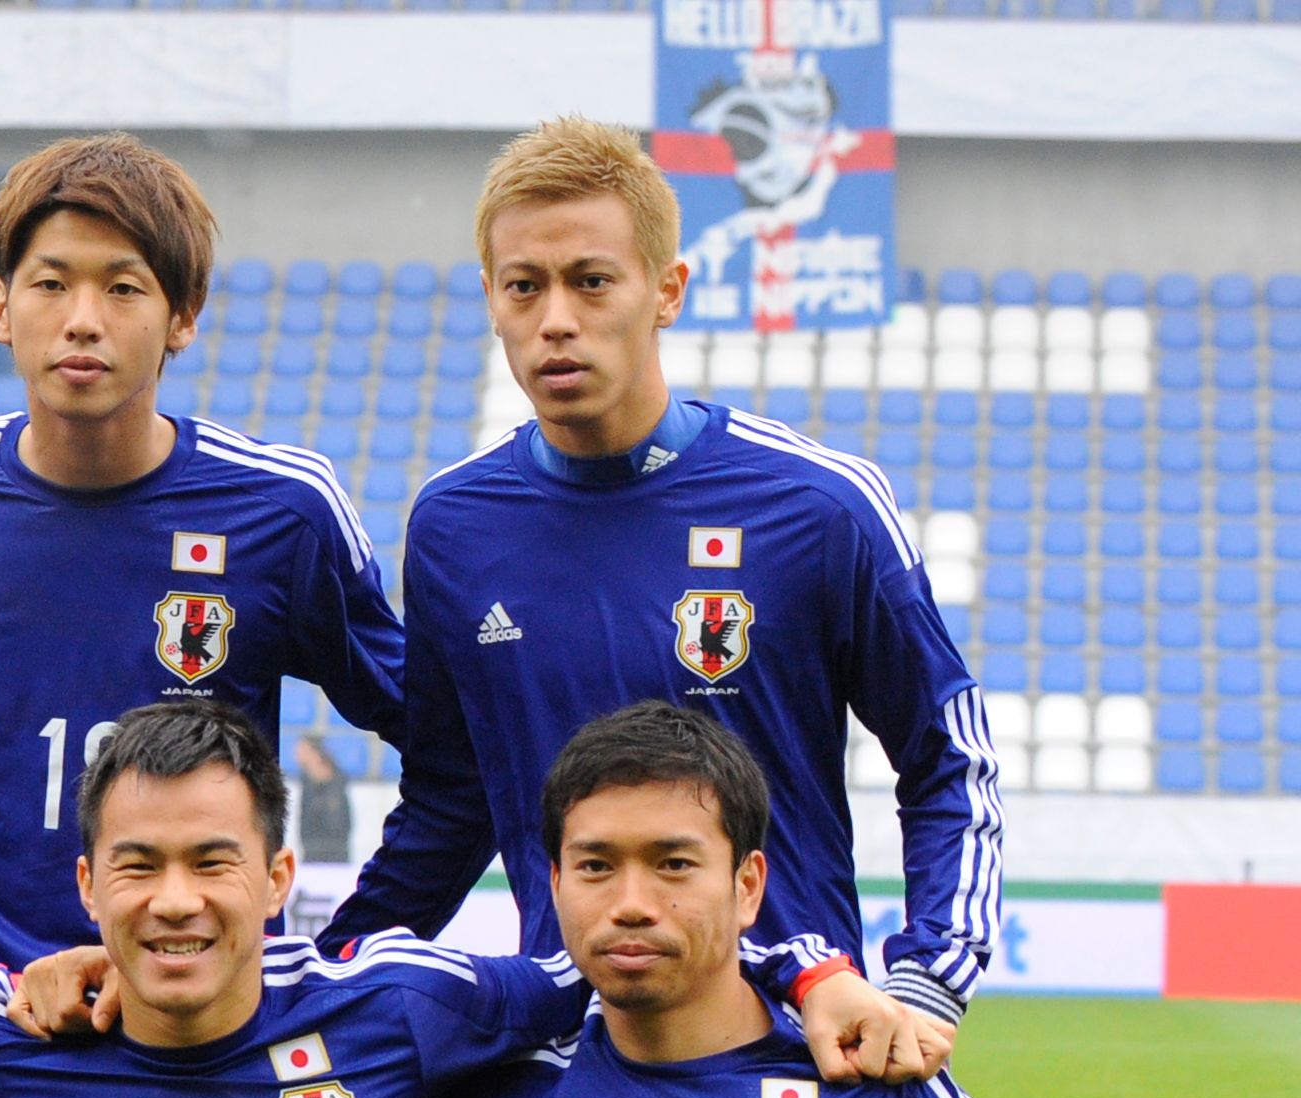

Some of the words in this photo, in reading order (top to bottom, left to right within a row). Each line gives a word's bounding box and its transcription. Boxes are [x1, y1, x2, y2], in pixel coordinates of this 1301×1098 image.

[478, 625, 523, 645] adidas
[161, 687, 213, 697] JAPAN
[684, 687, 739, 696] JAPAN
